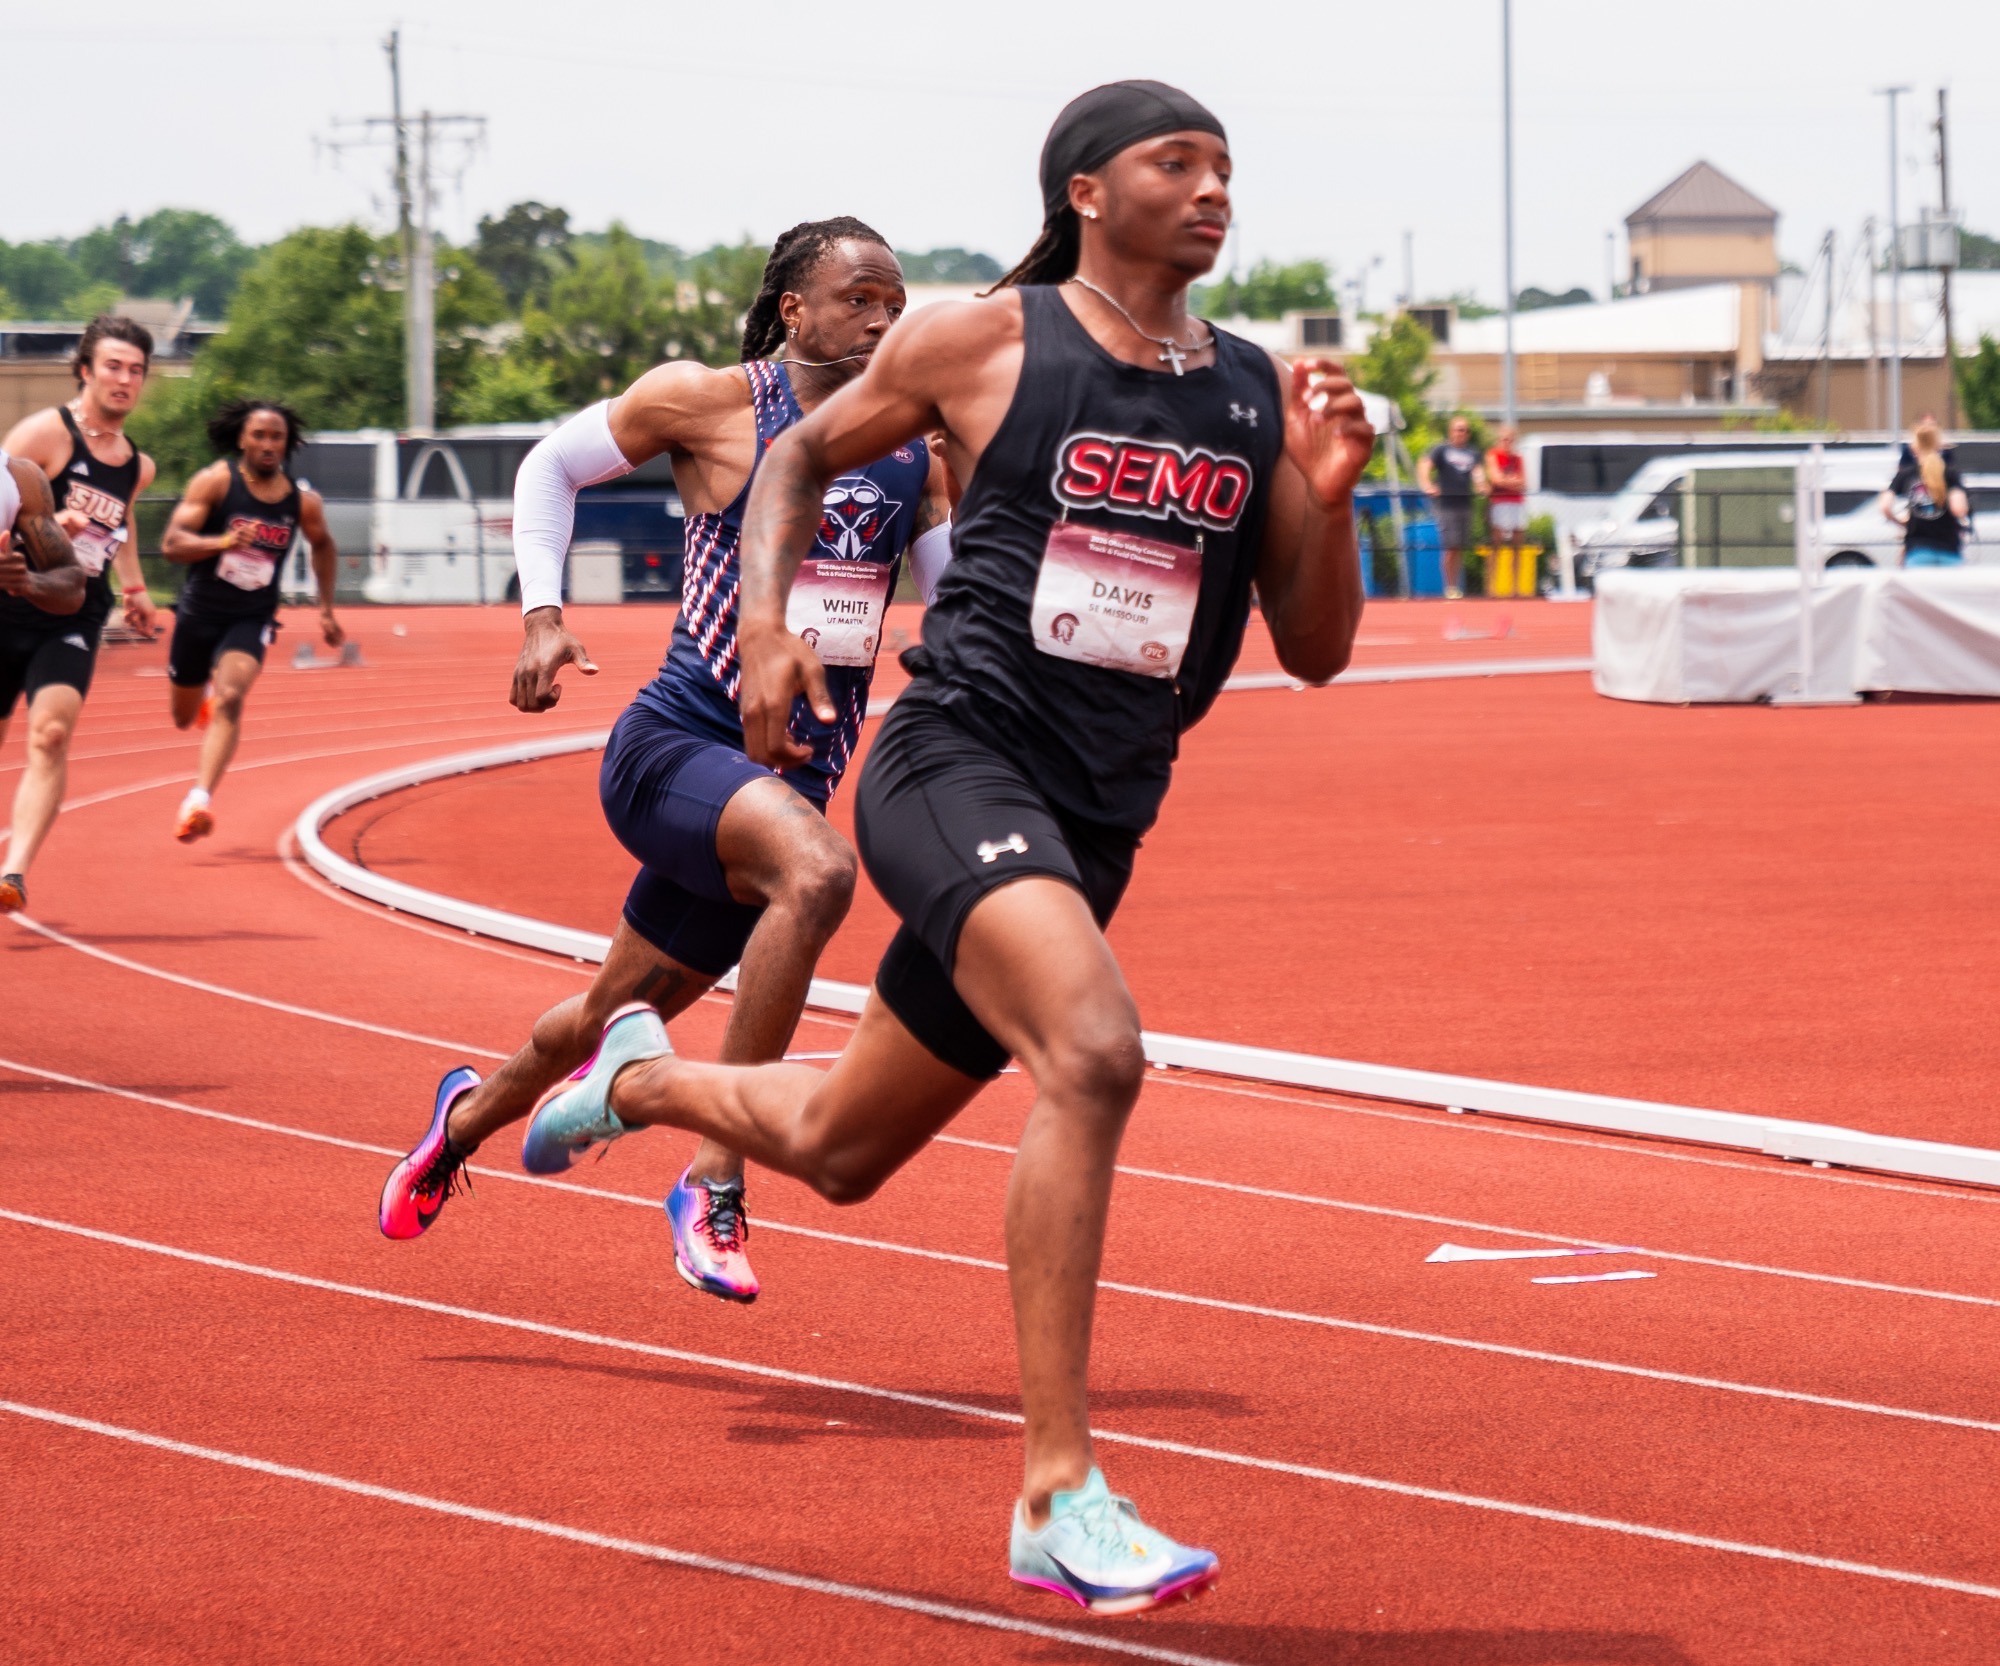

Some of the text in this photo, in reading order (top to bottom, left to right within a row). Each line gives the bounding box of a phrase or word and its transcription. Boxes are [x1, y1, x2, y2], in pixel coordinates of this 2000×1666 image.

[1056, 437, 1250, 526] SEMO
[68, 484, 125, 527] SIUE
[1089, 544, 1107, 554] Track
[1114, 550, 1130, 559] Field
[1130, 553, 1174, 569] Championships
[1108, 539, 1124, 548] Ohio
[1124, 543, 1142, 553] Valley
[1142, 547, 1175, 560] Conference
[823, 599, 869, 615] WHITE
[1091, 581, 1155, 611] DAVIS
[838, 617, 864, 626] MARTIN
[1088, 603, 1150, 625] SE MISSOURI
[1145, 647, 1164, 659] OVC
